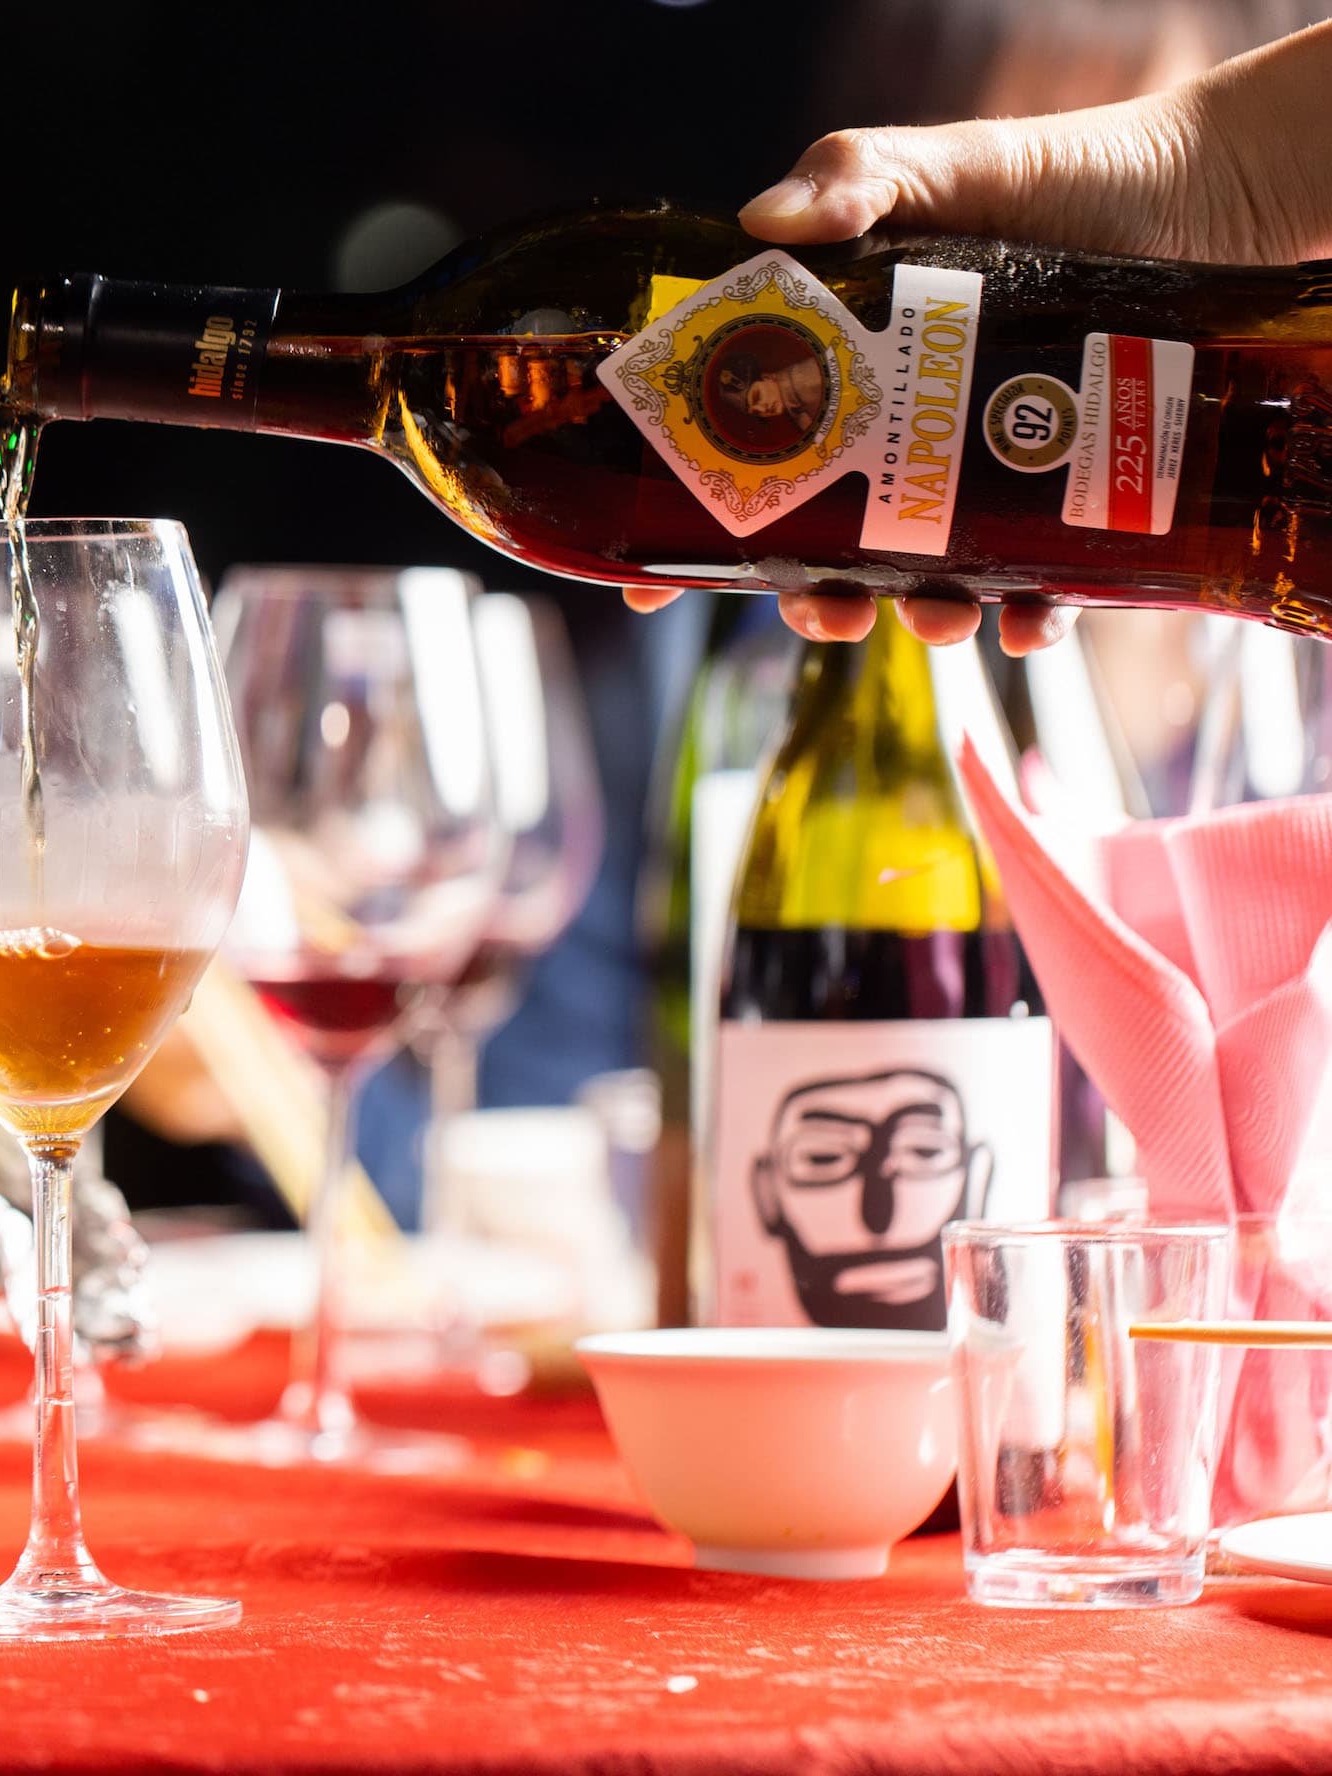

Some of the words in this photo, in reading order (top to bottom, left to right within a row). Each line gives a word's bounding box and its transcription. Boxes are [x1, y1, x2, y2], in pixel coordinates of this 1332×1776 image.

[188, 316, 236, 397] hidalgo
[237, 319, 258, 354] 1792
[230, 363, 247, 400] since
[879, 307, 916, 504] AMONTILLADO
[989, 382, 1027, 426] SPECTATOR
[1115, 377, 1133, 428] AÑOS
[1134, 379, 1146, 429] YEARS
[897, 296, 970, 524] NAPOLEON
[1012, 404, 1052, 441] 92
[1057, 407, 1075, 446] POINTS
[1069, 431, 1097, 518] BODEGAS
[1083, 342, 1106, 426] HIDALGO
[992, 431, 1012, 453] WINE
[1166, 459, 1178, 480] JEREZ
[1173, 398, 1186, 426] SHERRY
[1116, 435, 1146, 495] 225
